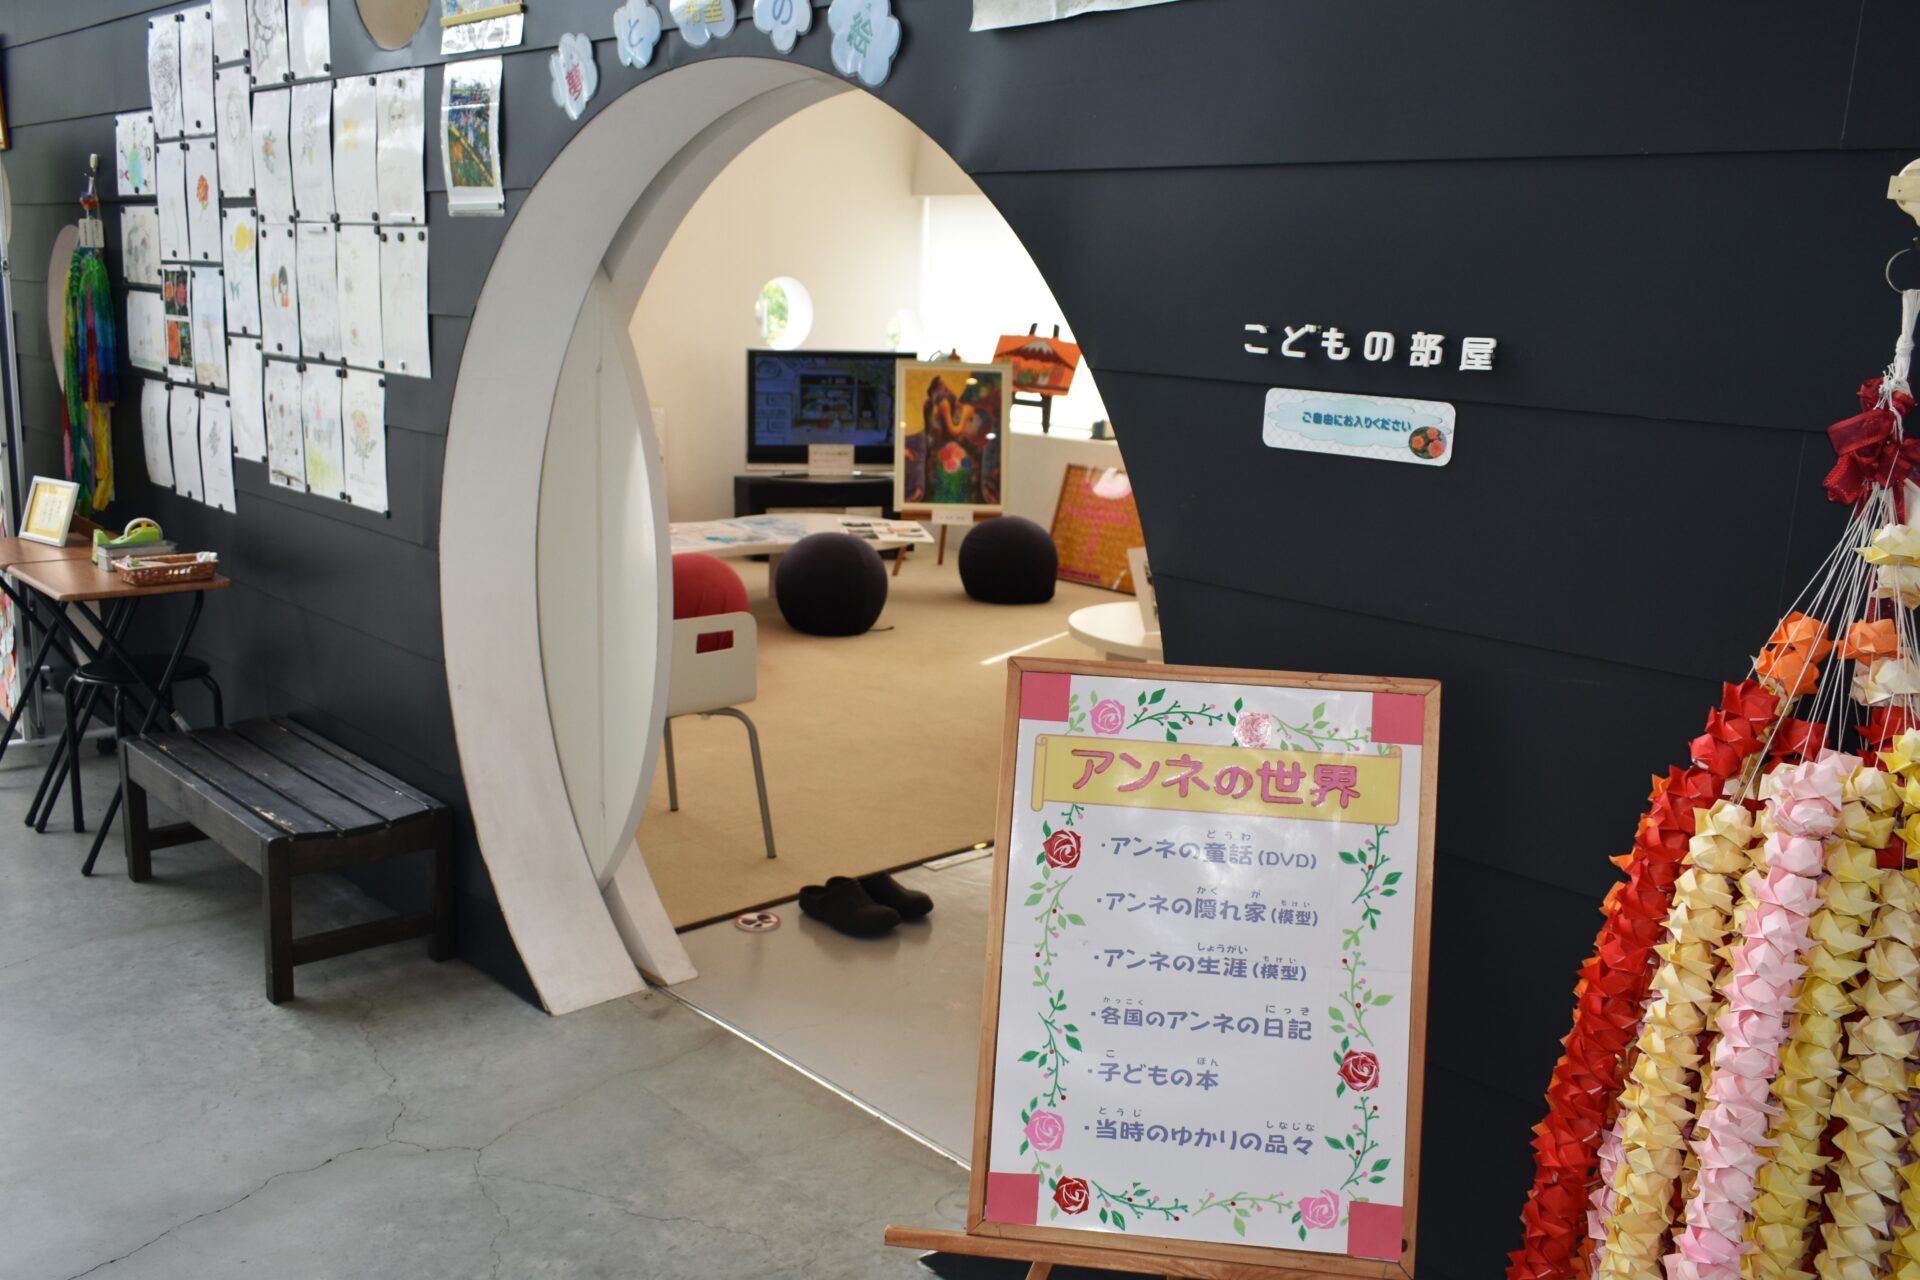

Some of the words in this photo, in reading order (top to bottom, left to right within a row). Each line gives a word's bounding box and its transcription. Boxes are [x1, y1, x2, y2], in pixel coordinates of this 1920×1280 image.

[1244, 323, 1496, 370] こどもの部屋
[1302, 411, 1411, 431] ご自由にお入りください
[1071, 749, 1360, 808] アンネの世界
[1207, 830, 1251, 841] どうわ
[1196, 886, 1217, 894] かく
[1197, 942, 1248, 954] しょうがい
[1103, 996, 1144, 1005] かっこく
[1265, 1004, 1309, 1016] にっき
[1197, 1057, 1219, 1067] ほん
[1098, 1106, 1142, 1118] とうじ
[1266, 1120, 1315, 1132] しなじな
